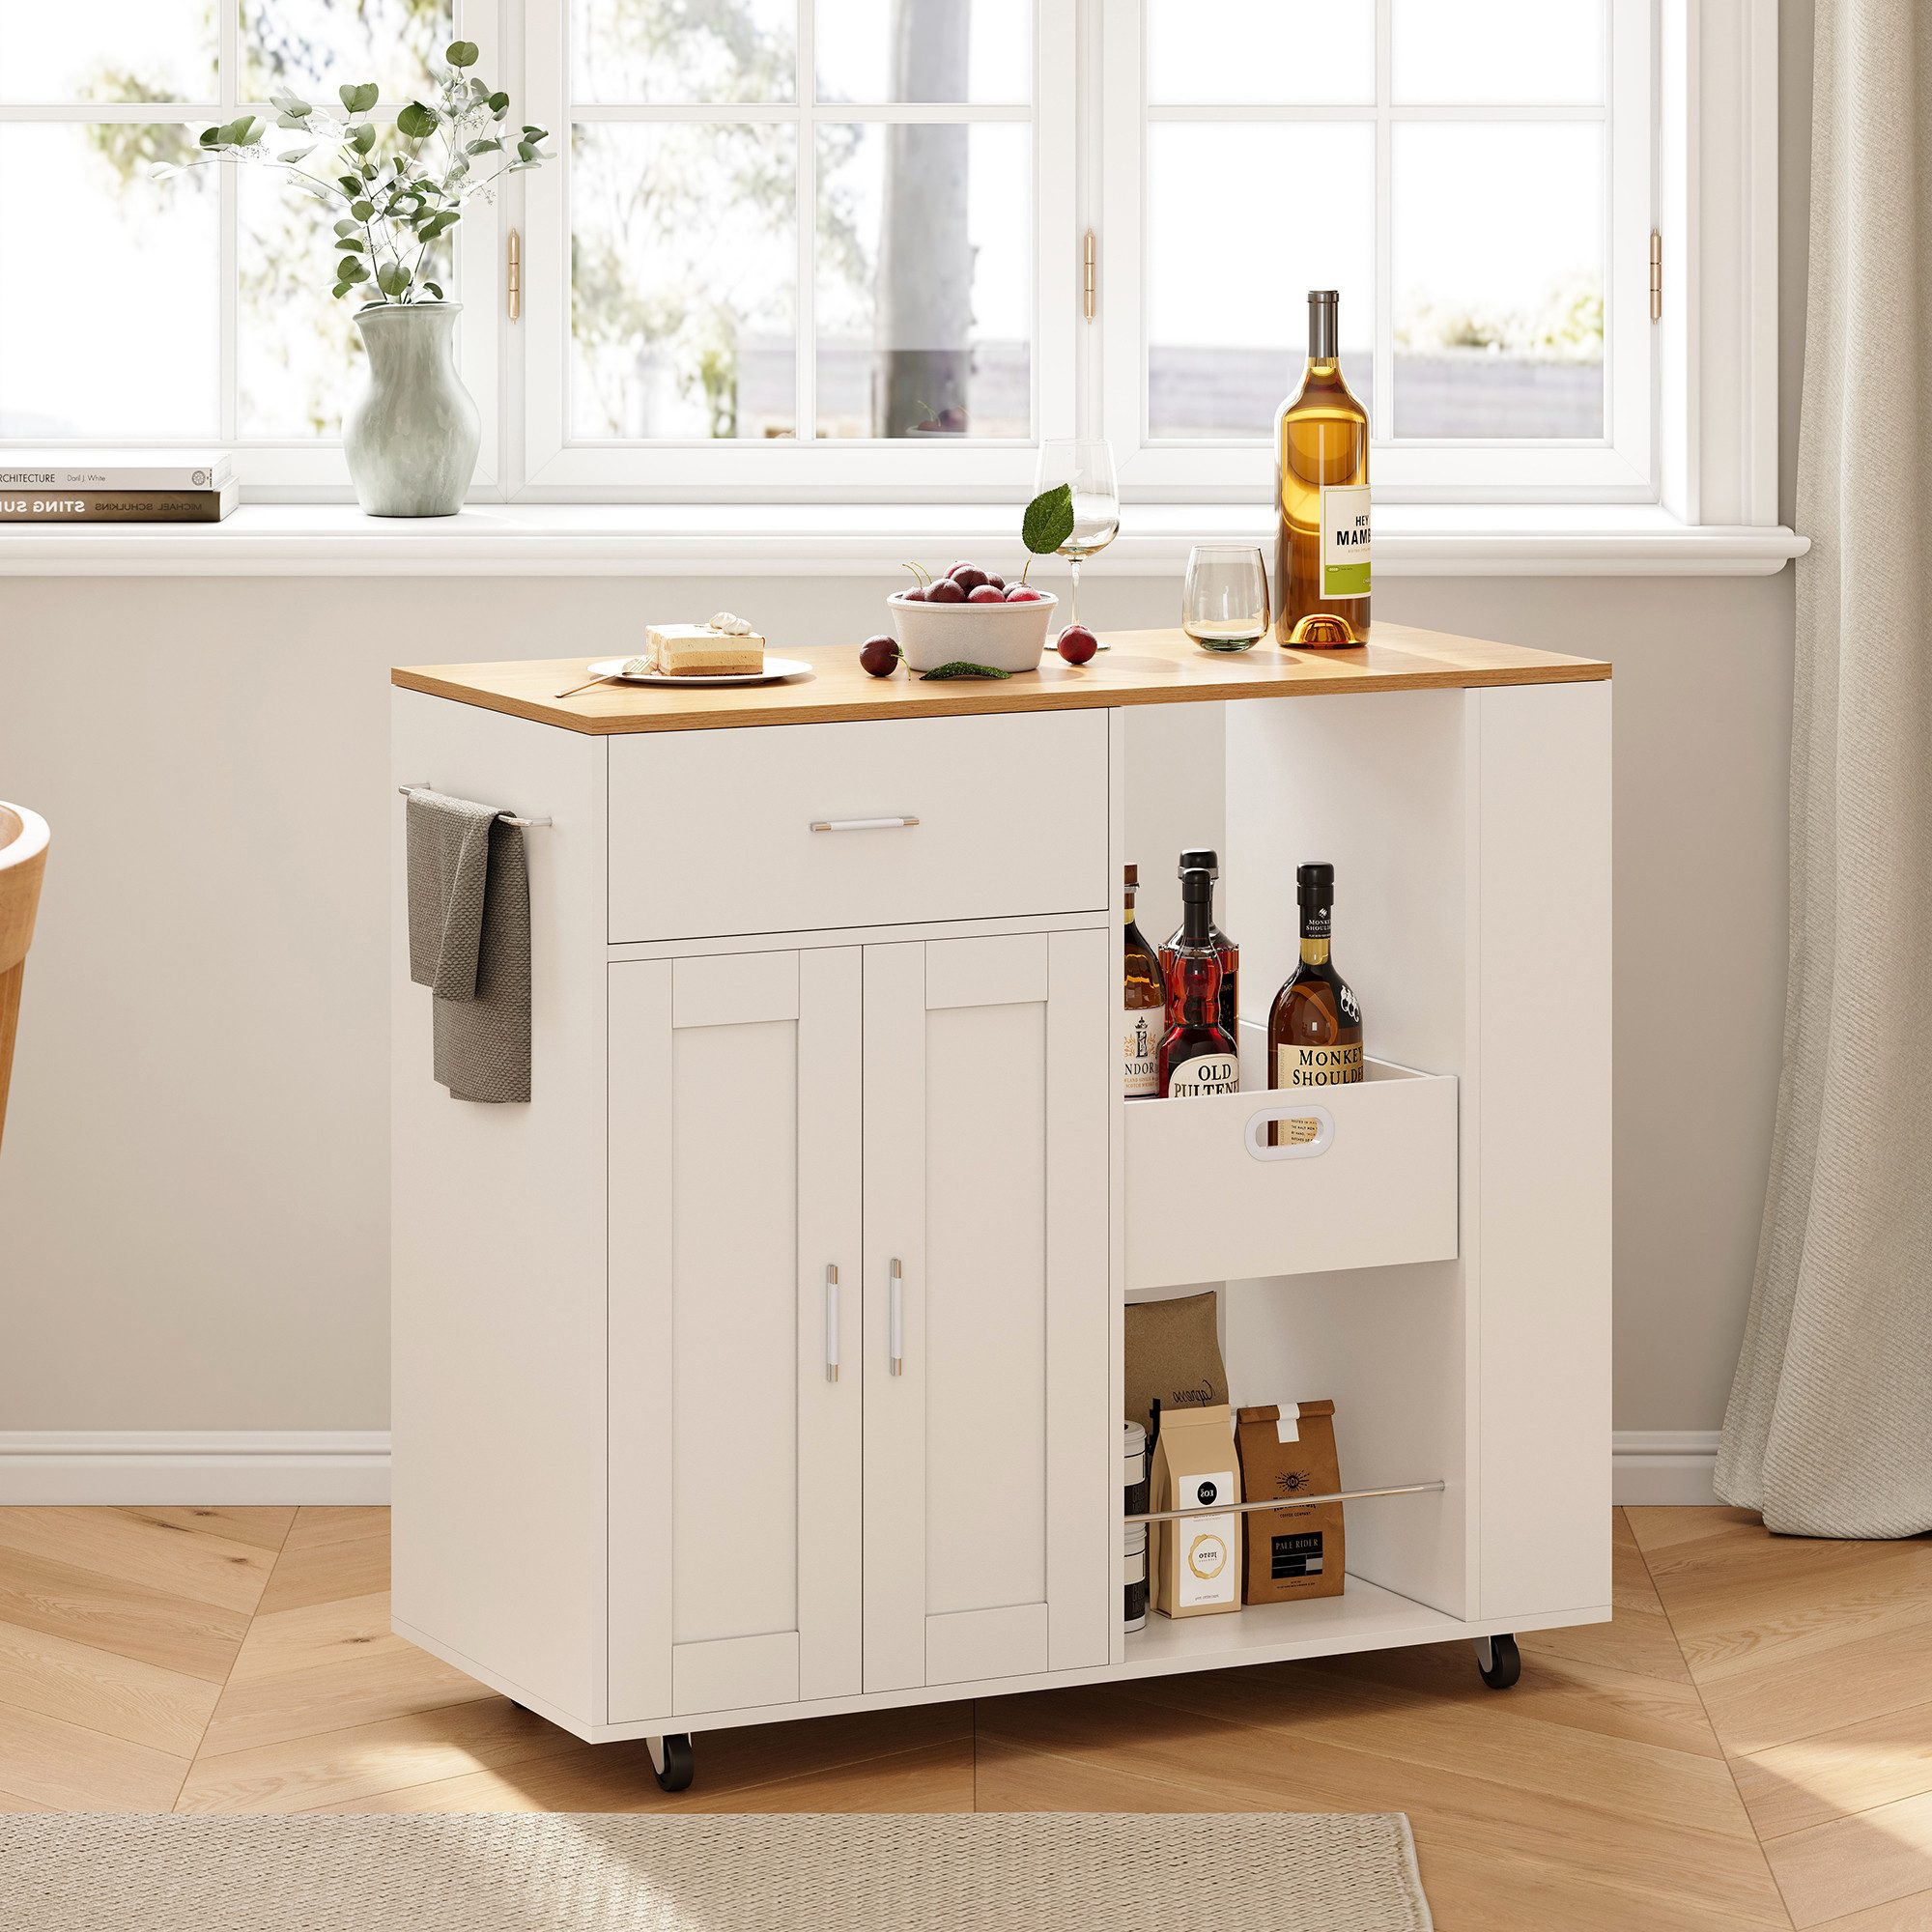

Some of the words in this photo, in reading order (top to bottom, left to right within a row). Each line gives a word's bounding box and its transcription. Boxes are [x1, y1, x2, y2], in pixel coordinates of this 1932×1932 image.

[1355, 515, 1369, 526] HEY
[1299, 1046, 1362, 1065] MONKEY
[1198, 1064, 1232, 1081] OLD
[1275, 1541, 1293, 1550] PALE
[1295, 1539, 1319, 1548] RIDER
